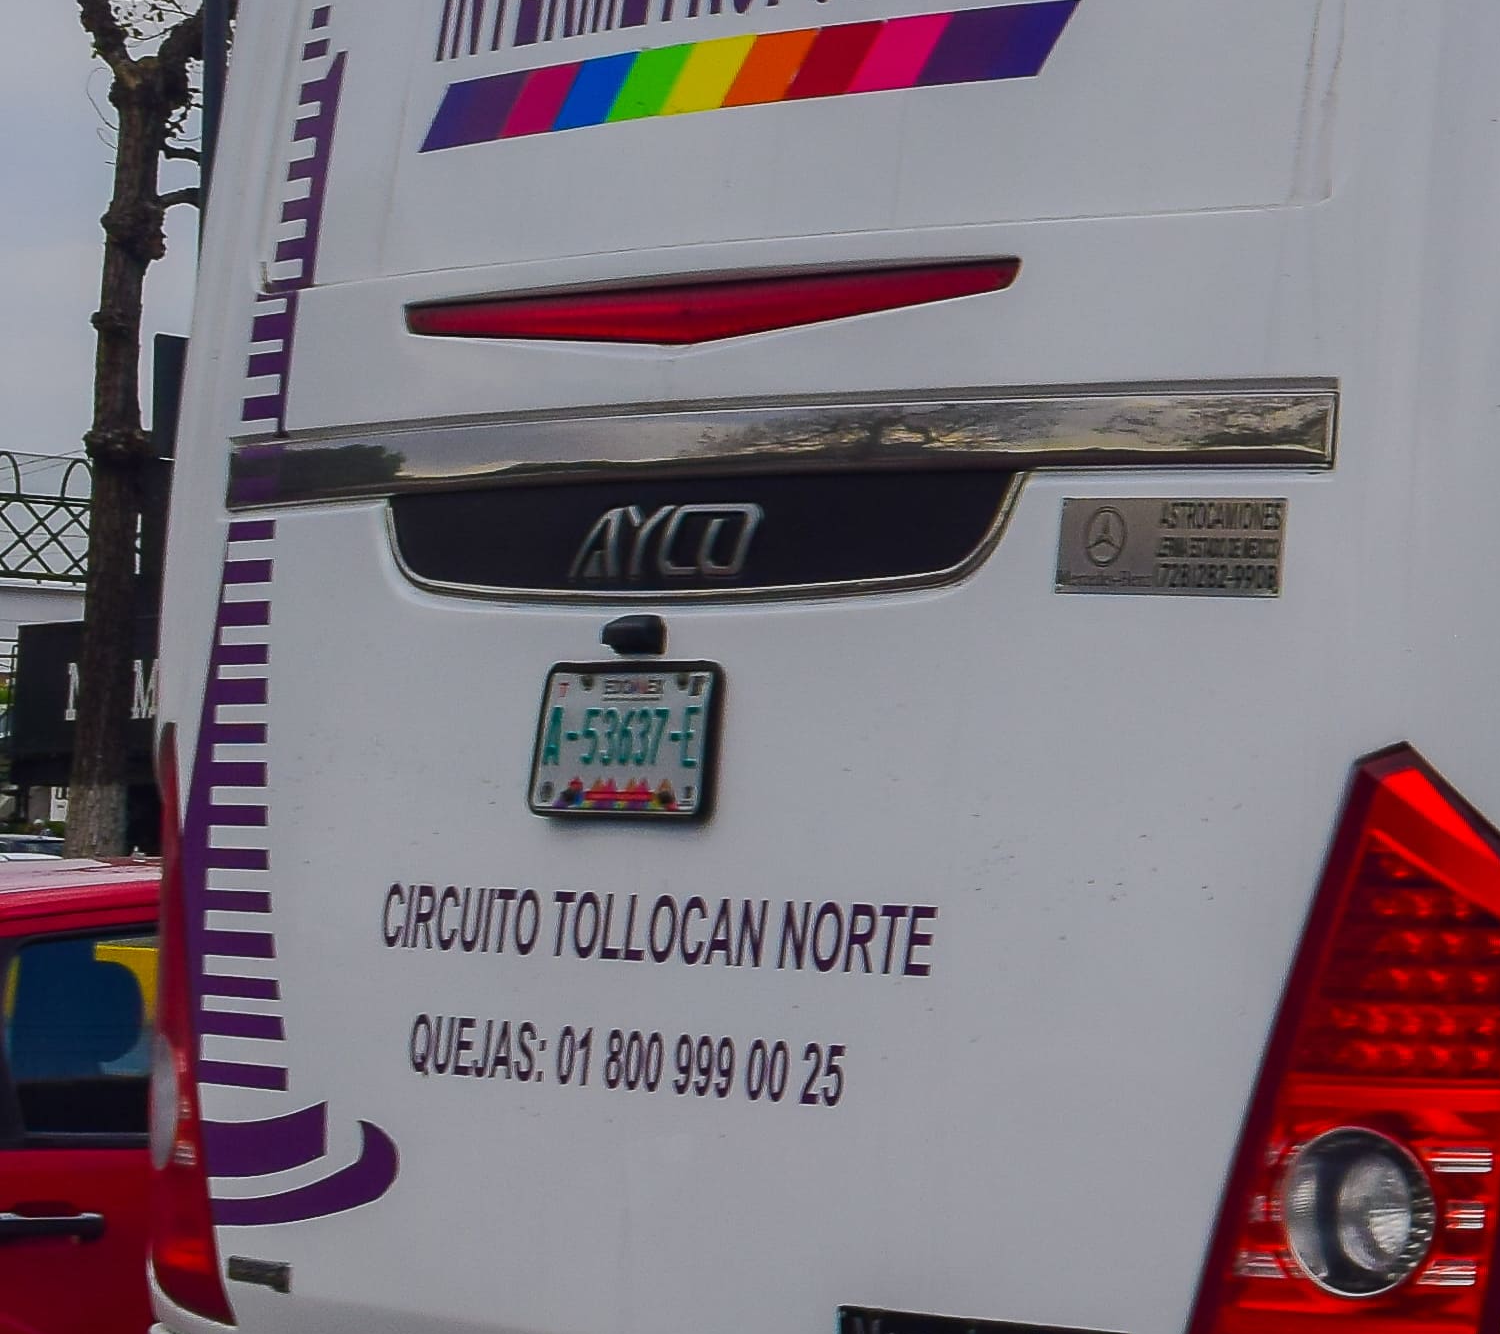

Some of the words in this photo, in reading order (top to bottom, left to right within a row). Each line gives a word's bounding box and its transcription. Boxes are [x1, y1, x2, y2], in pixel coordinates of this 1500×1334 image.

[567, 504, 764, 580] AYCO
[543, 706, 702, 767] A-53637-E
[380, 881, 541, 957] CIRCUITO
[552, 890, 765, 971] TOLLOCAN
[775, 901, 938, 978] NORTE
[408, 1013, 548, 1085] QUEJAS:
[555, 1027, 592, 1087] 01
[604, 1029, 661, 1092] 800
[673, 1033, 730, 1098] 999
[745, 1038, 787, 1099] 00
[800, 1044, 846, 1107] 25
